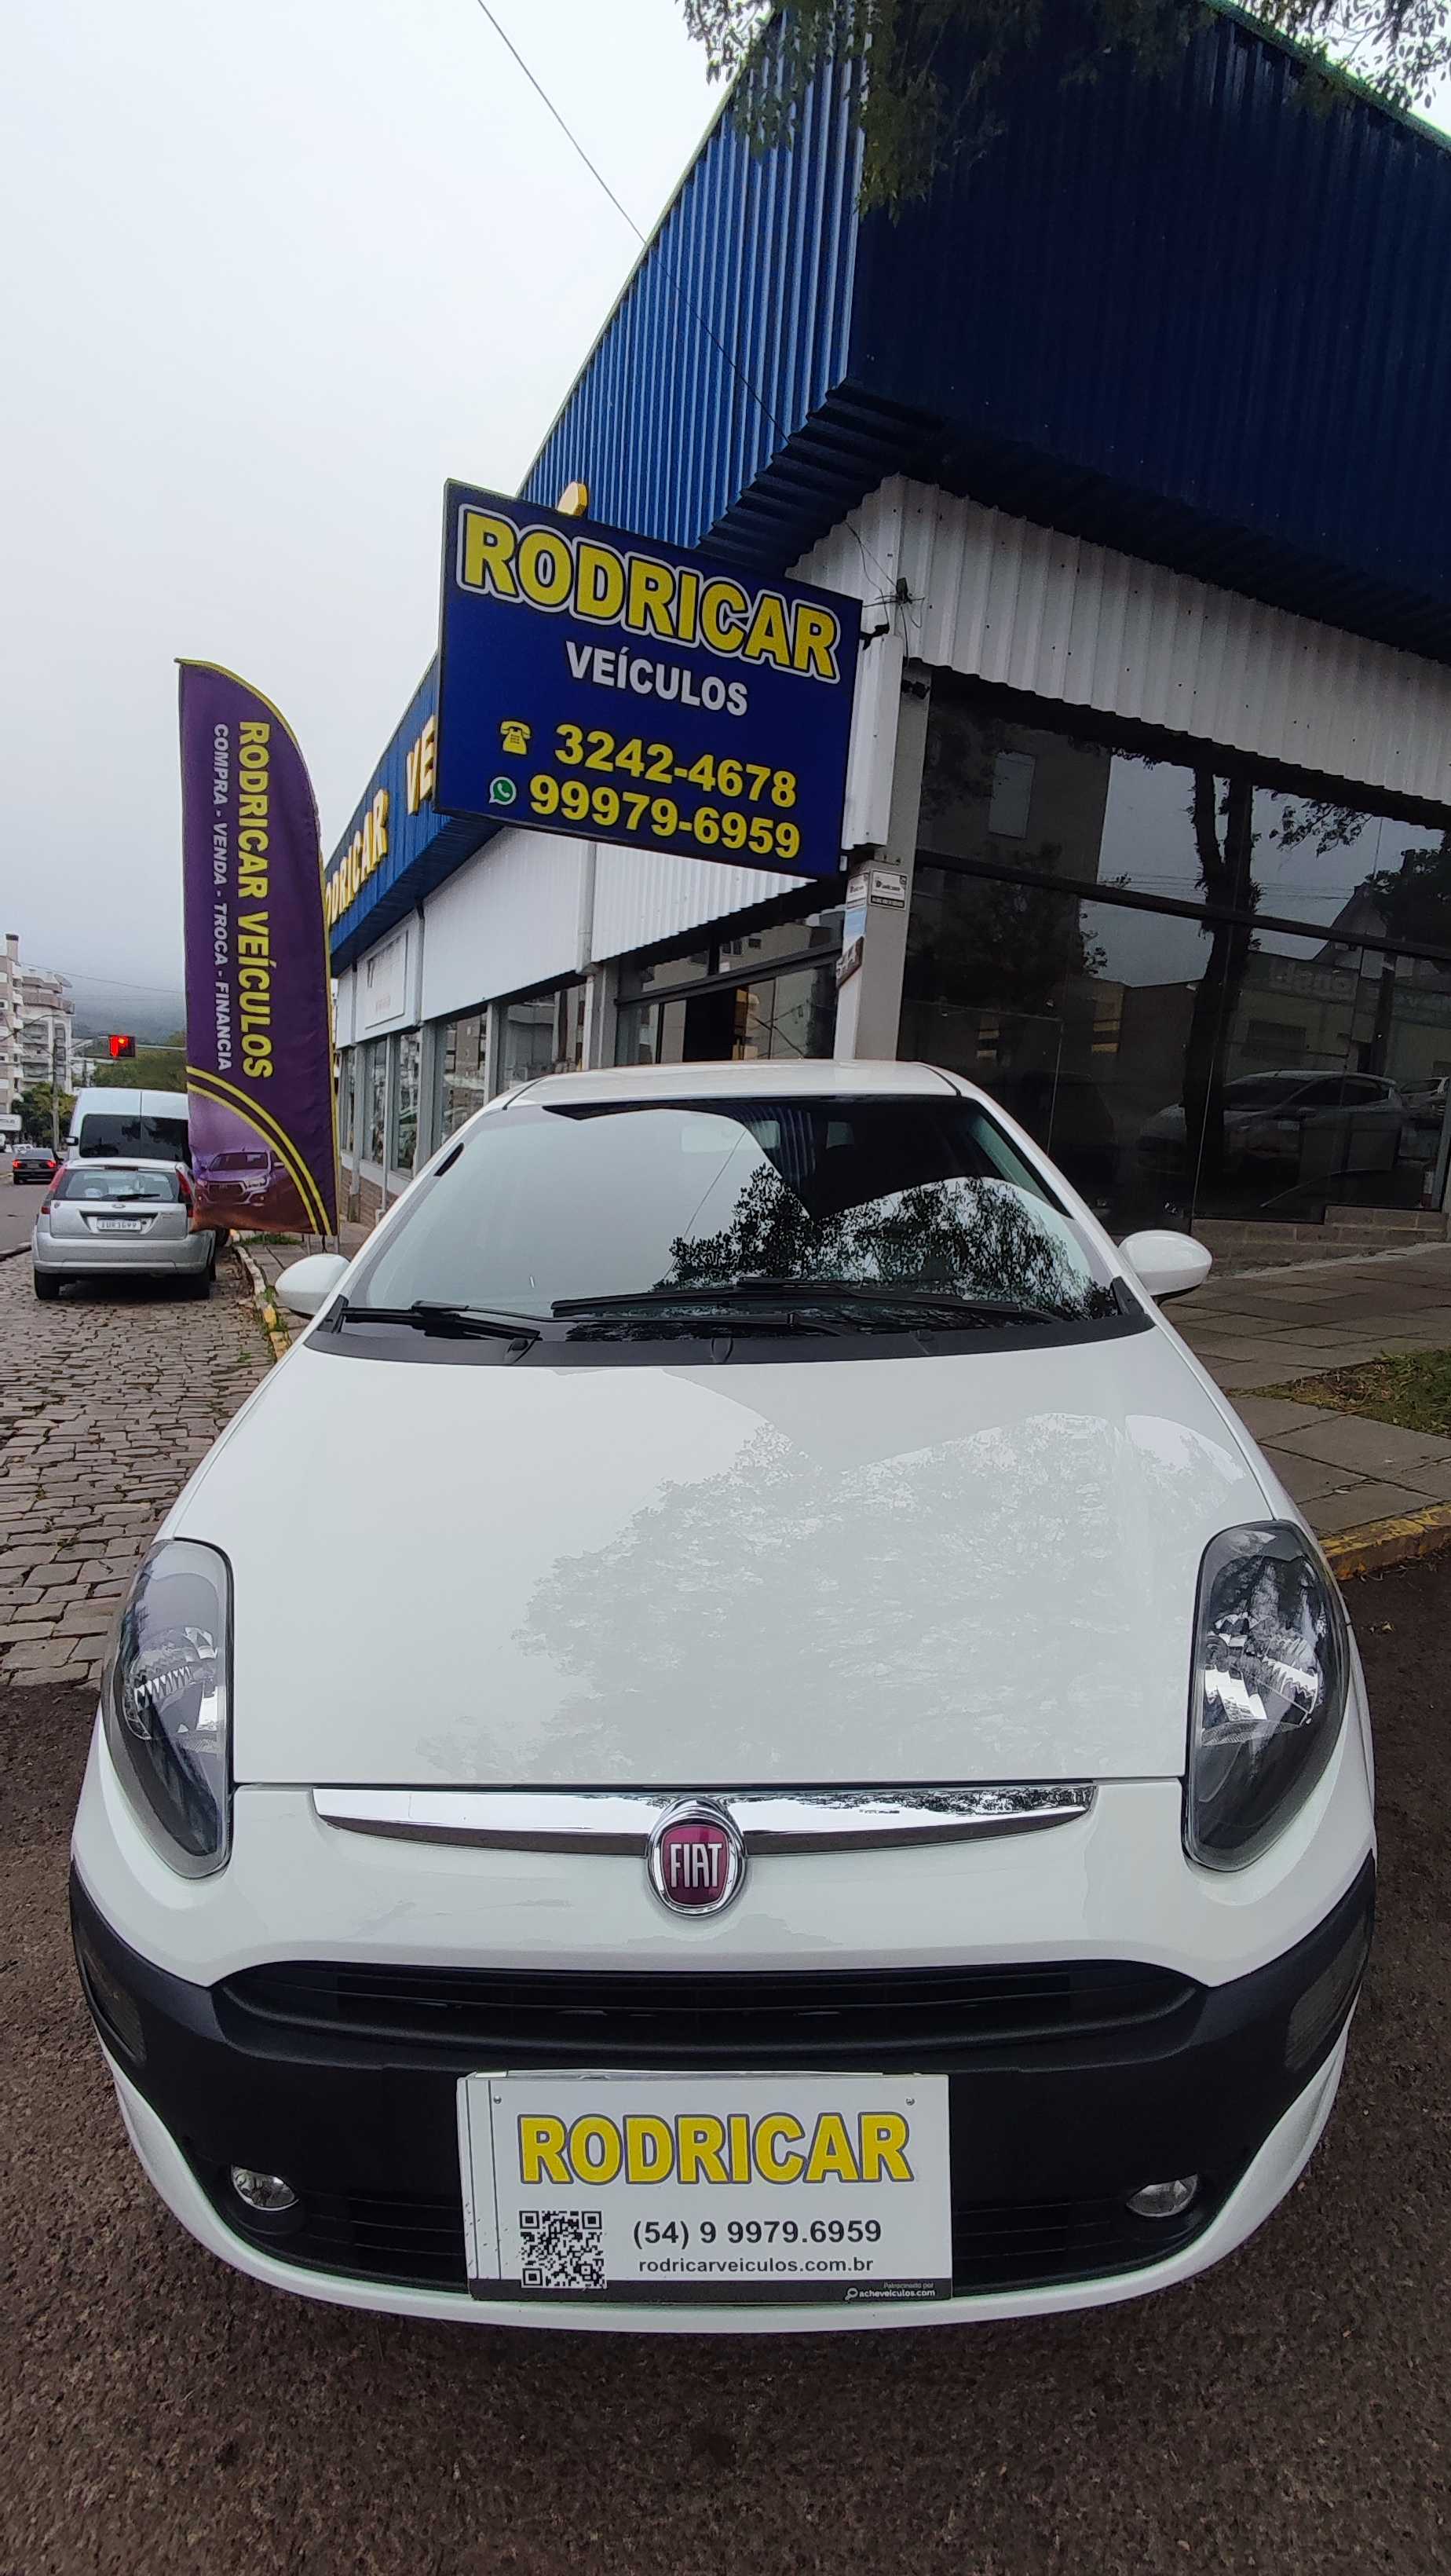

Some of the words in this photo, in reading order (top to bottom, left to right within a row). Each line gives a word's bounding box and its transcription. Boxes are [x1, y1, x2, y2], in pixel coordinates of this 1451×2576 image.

[458, 505, 839, 682] RODRICAR
[565, 641, 748, 716] VEÍCULOS
[214, 723, 228, 805] COMPRA
[555, 723, 797, 809] 3242-4678
[238, 721, 270, 898] RODRICAR
[529, 774, 800, 858] 99979-6959
[213, 823, 228, 885] VENDA
[214, 903, 228, 965] TROCA
[215, 982, 232, 1070] FINANCIA
[238, 911, 276, 1078] VEÍCULOS
[670, 1842, 722, 1888] FIAT
[517, 2112, 915, 2185] RODRICAR
[634, 2220, 689, 2249] (54)
[700, 2221, 716, 2244] 9
[727, 2219, 882, 2244] 9979.6959
[639, 2257, 873, 2272] rodricarveiculos.com.br
